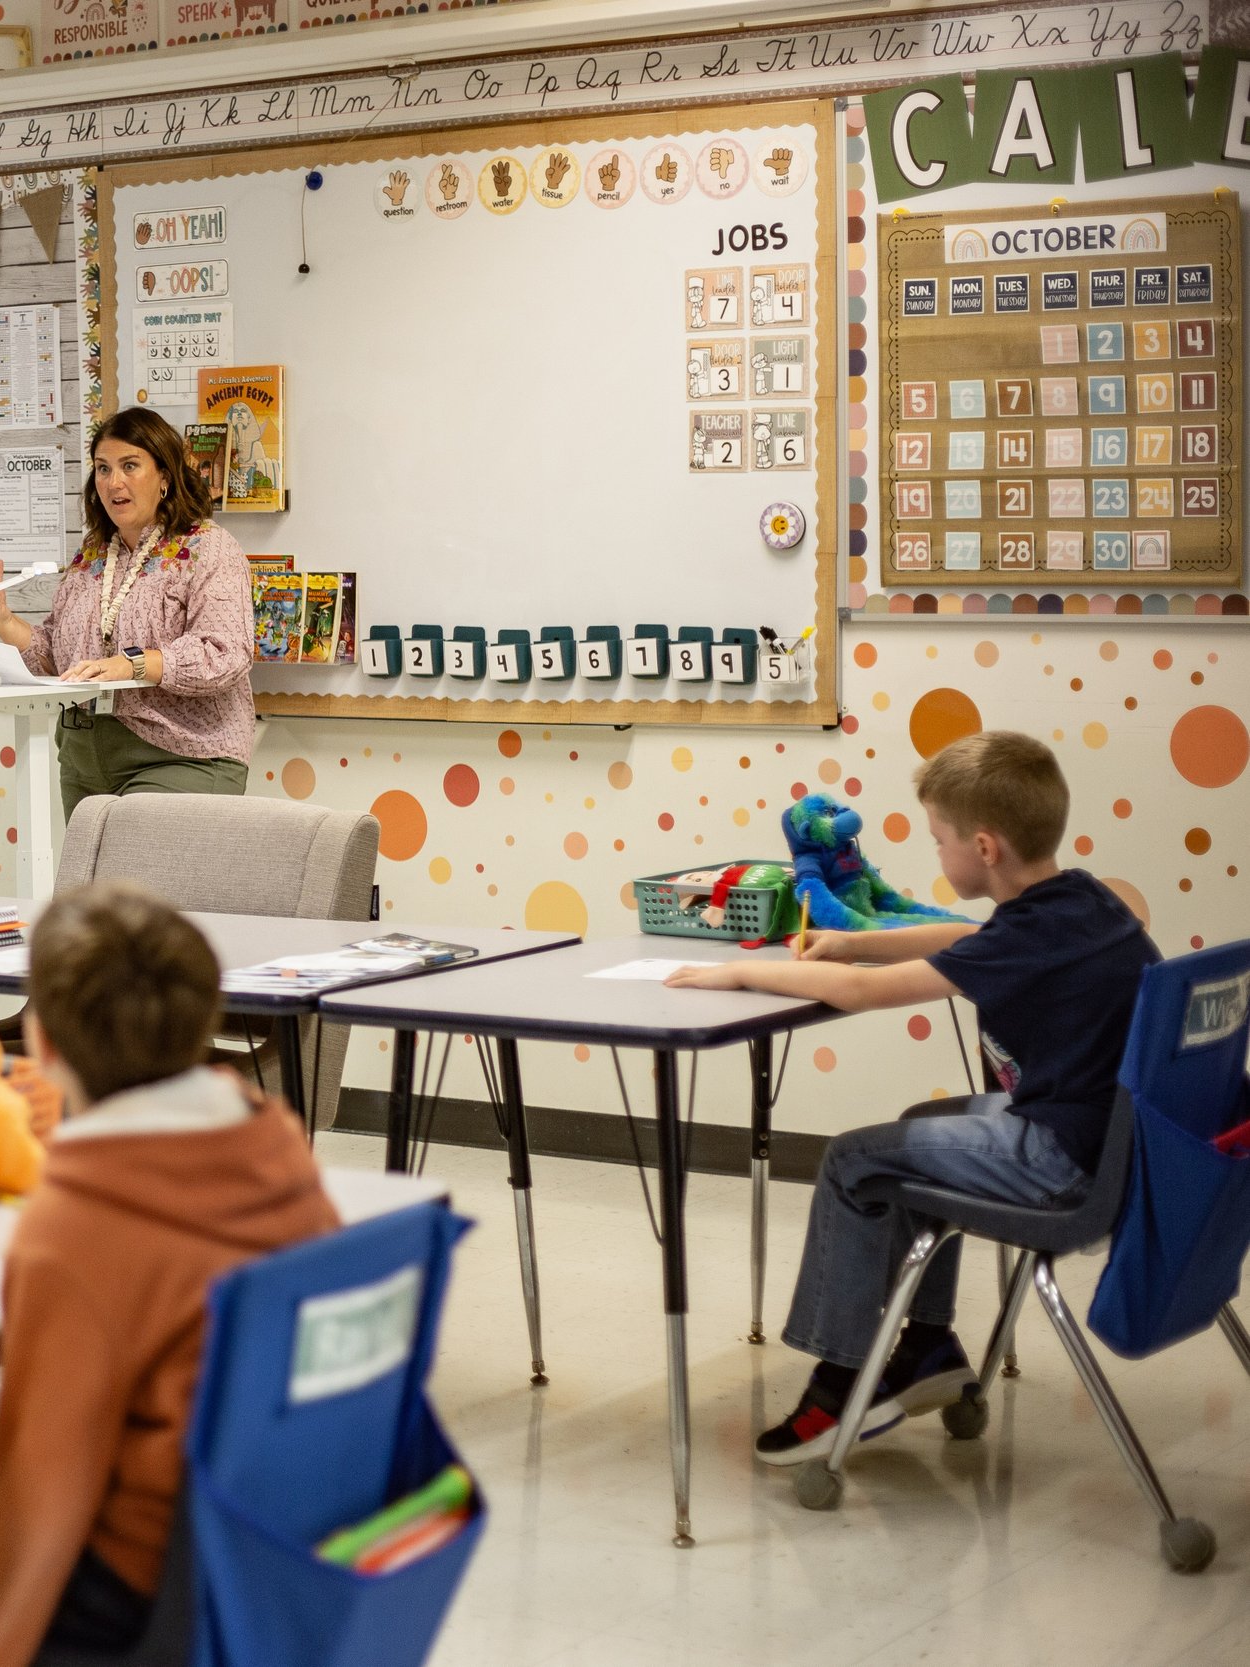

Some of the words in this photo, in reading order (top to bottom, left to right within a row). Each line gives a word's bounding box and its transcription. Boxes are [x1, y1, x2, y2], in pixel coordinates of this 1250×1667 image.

[177, 2, 218, 24] SPEAK
[54, 20, 128, 45] RESPONSIBLE
[16, 119, 52, 158] Gg
[66, 111, 100, 143] Hh
[113, 107, 150, 137] Ii
[162, 103, 186, 145] Jj
[200, 96, 241, 127] Kk
[257, 90, 293, 122] Ll
[310, 85, 375, 118] Mm
[391, 77, 442, 108] Nn
[463, 69, 503, 101] Oo
[524, 62, 560, 107] Pp
[576, 58, 622, 101] Qq
[639, 51, 682, 85] Rr
[700, 44, 740, 78] Ss
[756, 38, 797, 73] Tt
[808, 34, 858, 68] Uu
[869, 28, 919, 60] Vv
[931, 20, 995, 57] Ww
[1010, 14, 1070, 49] Xx
[1088, 6, 1141, 58] Yy
[1159, 0, 1204, 51] Zz
[660, 187, 675, 198] yes
[719, 182, 731, 191] no
[770, 176, 790, 187] wait
[492, 197, 514, 209] water
[541, 187, 564, 200] tissue
[596, 190, 621, 203] pencil
[383, 206, 414, 219] question
[435, 200, 468, 213] restroom
[156, 216, 177, 242] OH
[181, 211, 223, 241] YEAH!
[711, 222, 789, 256] JOBS
[991, 224, 1117, 255] OCTOBER
[170, 264, 214, 294] OOPS!
[953, 282, 982, 294] MON.
[999, 281, 1026, 292] TUES.
[1048, 278, 1075, 290] WED.
[1093, 275, 1124, 287] THUR.
[1140, 273, 1164, 285] FRI.
[1182, 271, 1206, 283] SAT.
[909, 285, 932, 297] SUN.
[1137, 288, 1167, 301] FRIDAY
[717, 297, 730, 320] 7
[781, 295, 794, 317] 4
[144, 315, 163, 326] COIN
[164, 313, 202, 326] COUNTER
[772, 340, 800, 355] LIGHT
[1056, 333, 1065, 355] 1
[1097, 330, 1114, 355] 2
[1144, 328, 1160, 353] 3
[1187, 325, 1204, 351] 4
[717, 368, 731, 391] 3
[206, 385, 244, 410] ANCIENT
[246, 386, 274, 408] EGYPT
[912, 388, 927, 413] 5
[1006, 386, 1021, 410] 7
[1099, 382, 1117, 408] 9
[1143, 381, 1167, 406] 10
[1192, 379, 1206, 404] 11
[700, 414, 741, 430] TEACHER
[776, 413, 796, 428] LINE
[722, 442, 733, 463] 2
[783, 439, 796, 461] 6
[900, 440, 924, 464] 12
[1003, 437, 1027, 462] 14
[1097, 434, 1121, 460] 16
[1141, 433, 1166, 459] 17
[1187, 432, 1211, 458] 18
[7, 459, 52, 472] OCTOBER
[901, 488, 926, 513] 19
[1004, 486, 1027, 511] 21
[1095, 485, 1126, 510] 23
[1138, 484, 1170, 510] 24
[1185, 484, 1216, 509] 25
[900, 538, 928, 563] 26
[1002, 537, 1031, 562] 28
[1096, 537, 1127, 563] 30
[370, 648, 376, 668] 1
[411, 646, 423, 667] 2
[453, 649, 464, 669] 3
[496, 654, 508, 674] 4
[541, 649, 553, 670] 5
[589, 649, 600, 670] 6
[635, 646, 647, 667] 7
[680, 650, 693, 672] 8
[721, 651, 732, 674] 9
[768, 657, 782, 680] 5
